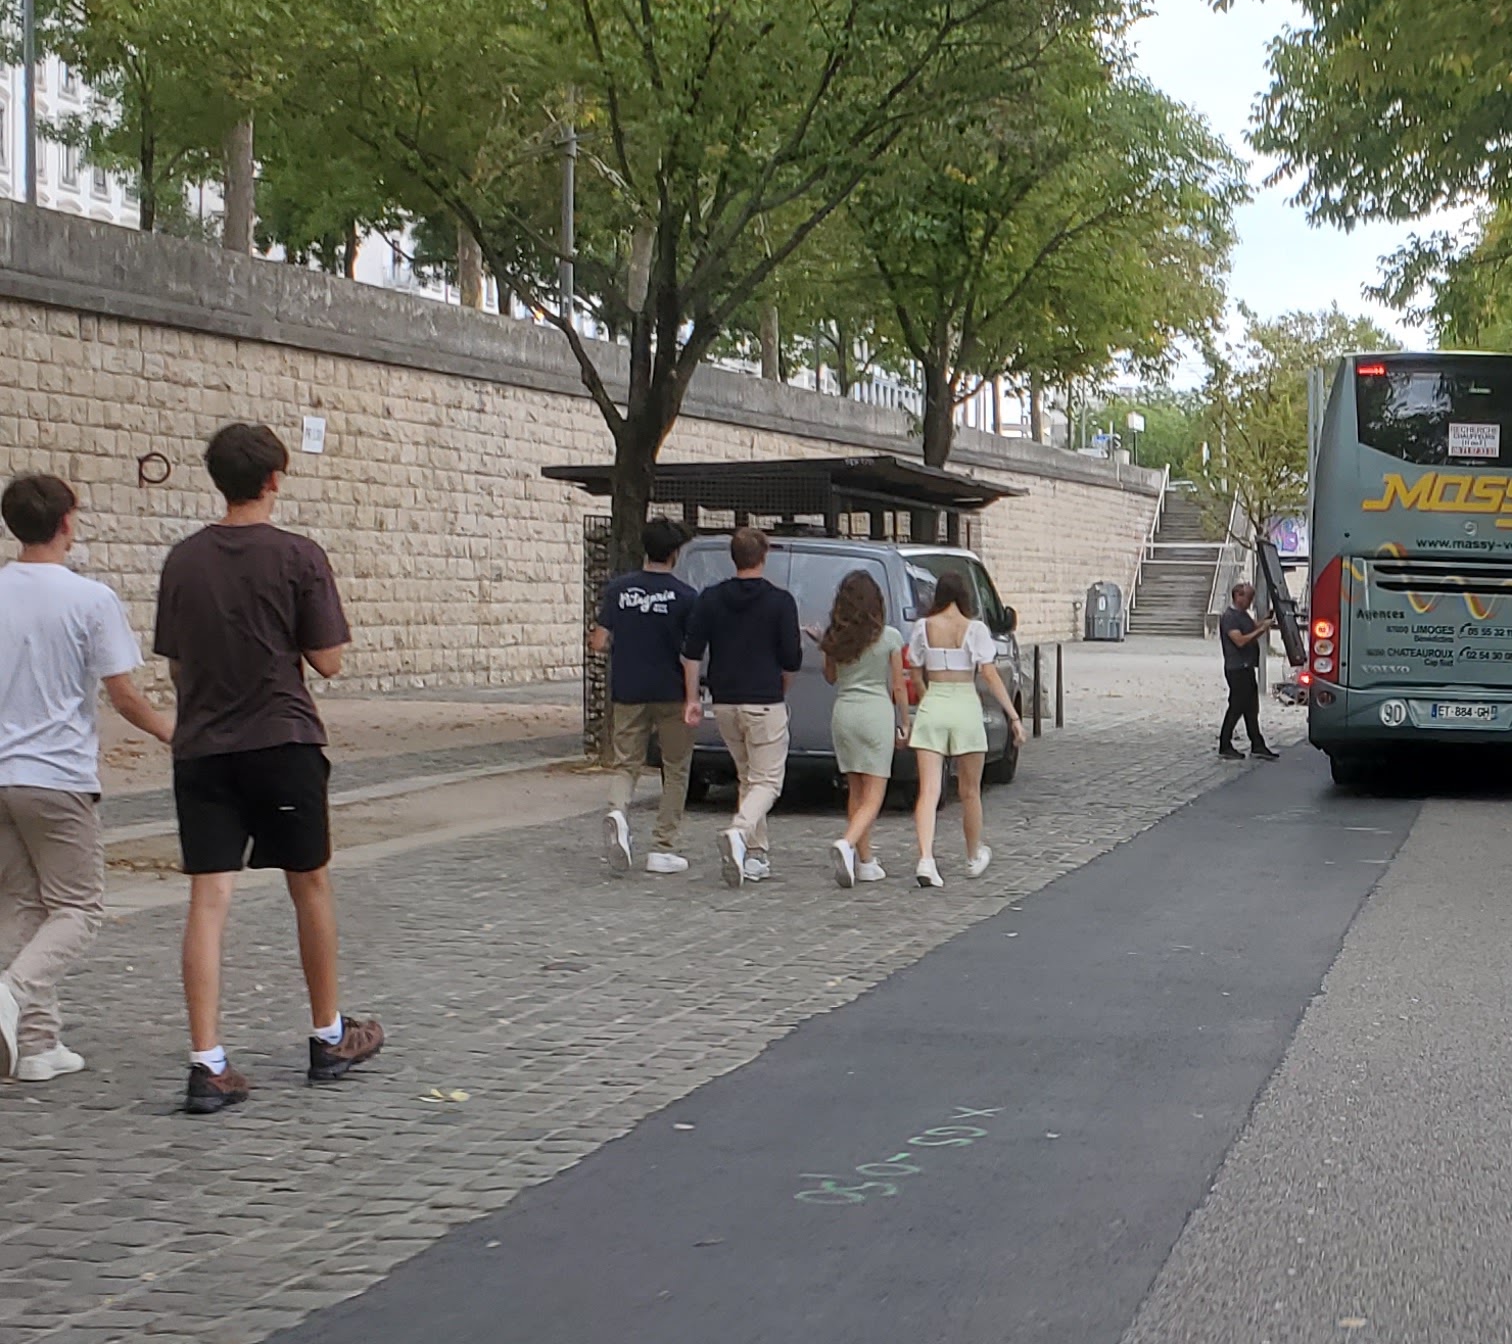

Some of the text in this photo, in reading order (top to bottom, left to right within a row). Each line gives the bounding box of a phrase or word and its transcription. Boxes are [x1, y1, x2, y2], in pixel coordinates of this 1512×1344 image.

[1356, 608, 1405, 621] Agences
[1411, 624, 1455, 635] LIMOGES
[1467, 627, 1479, 636] 05
[1481, 627, 1492, 636] 55
[1494, 628, 1505, 637] 32
[1387, 647, 1454, 659] CHATEAUROUX
[1466, 650, 1477, 660] 02
[1479, 651, 1490, 660] 54
[1492, 652, 1503, 661] 30
[1384, 703, 1401, 723] 90
